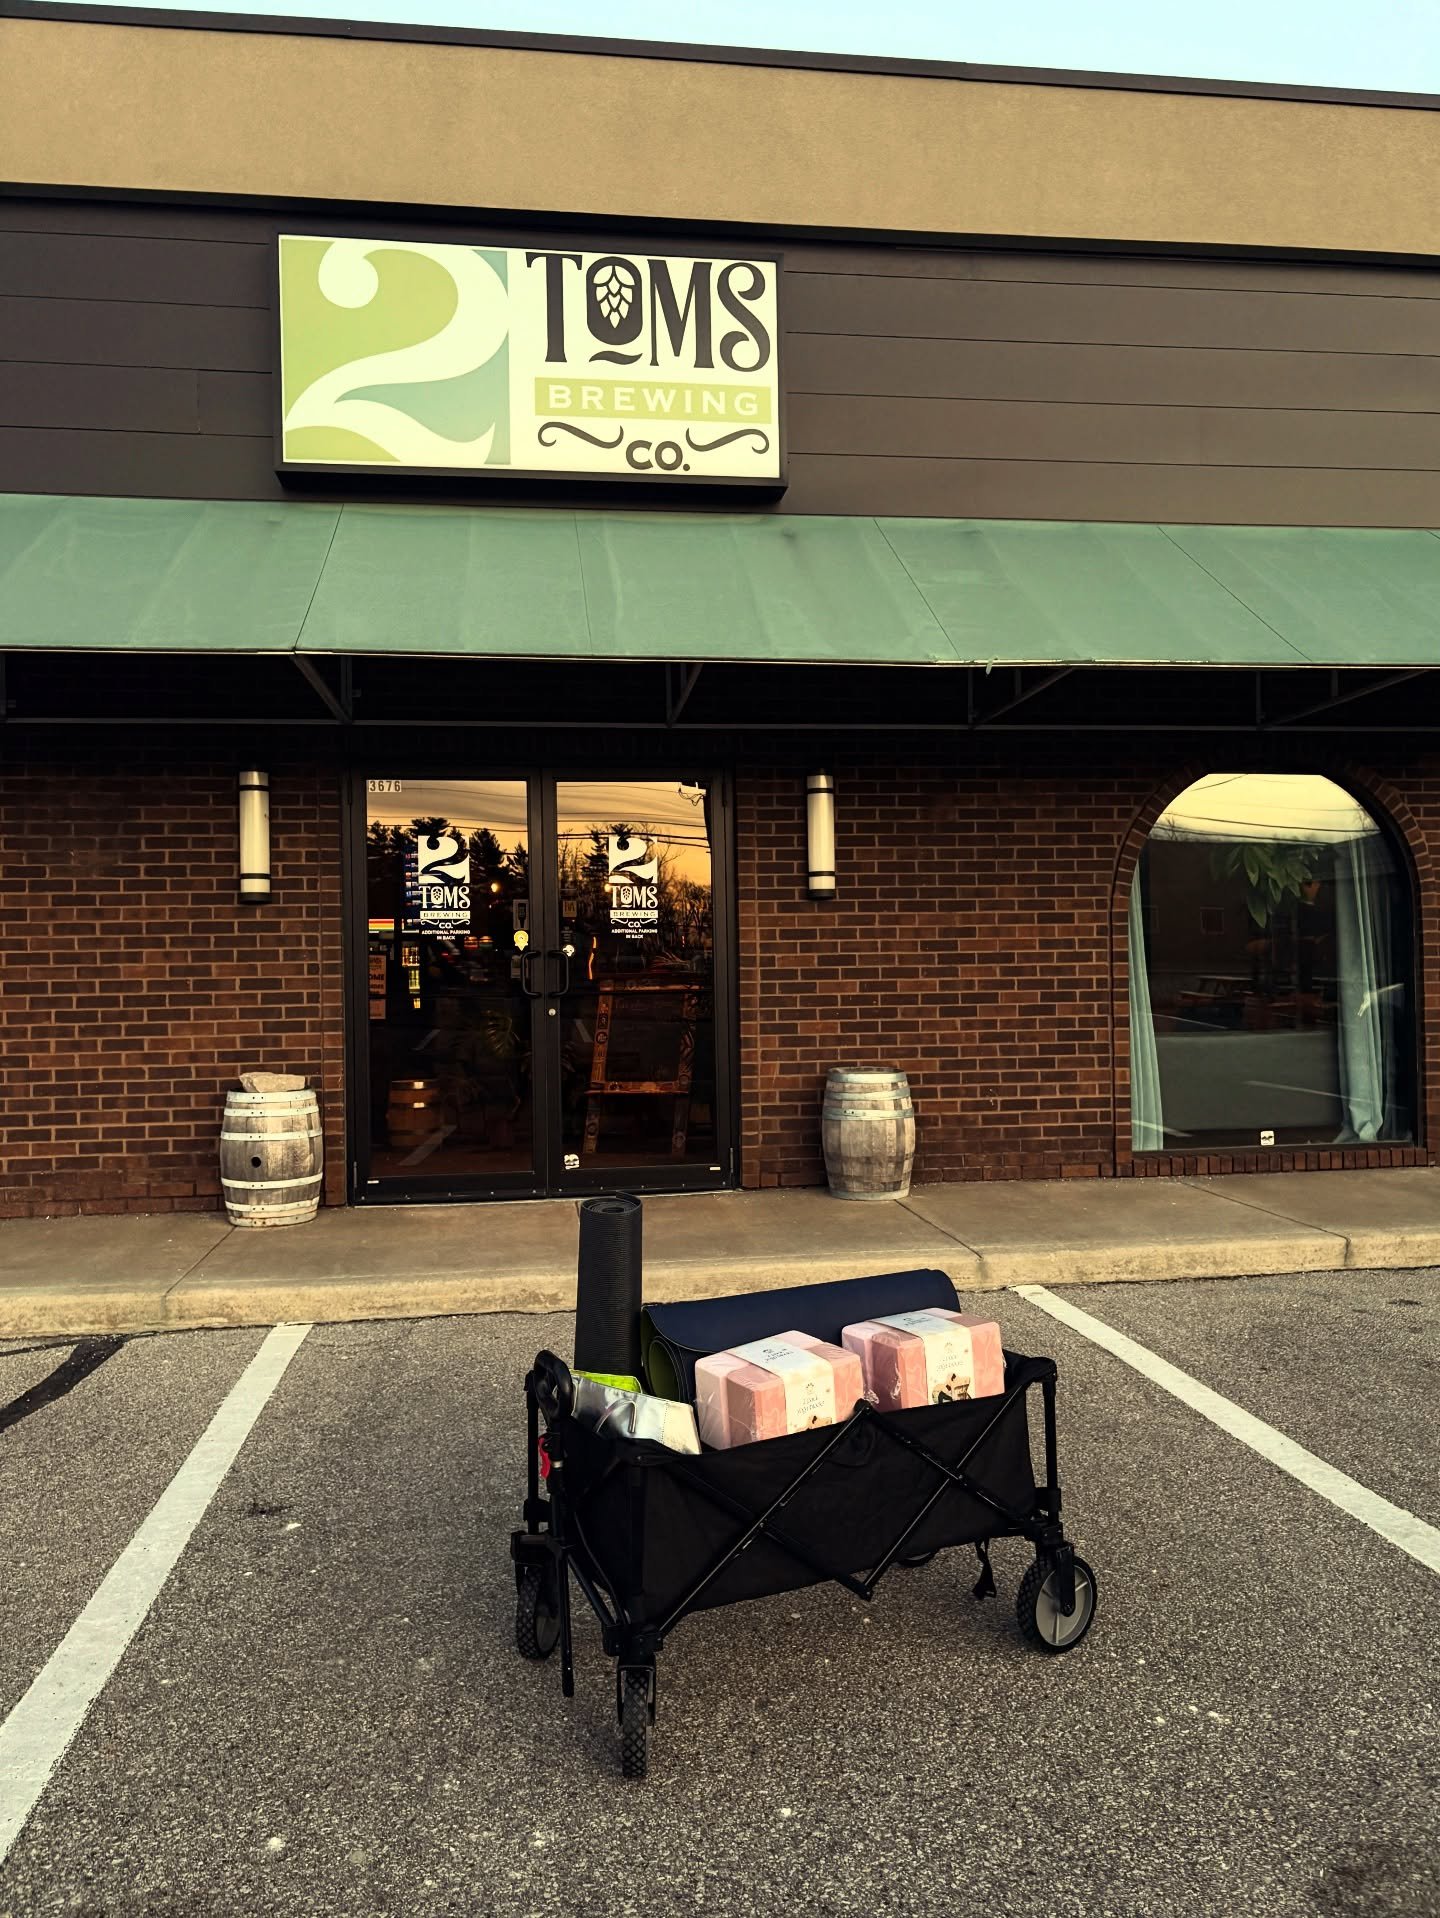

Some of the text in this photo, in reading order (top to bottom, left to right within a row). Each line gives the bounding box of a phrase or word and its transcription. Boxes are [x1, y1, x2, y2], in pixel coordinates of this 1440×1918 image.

[284, 240, 771, 465] 2 TOMS
[548, 384, 759, 416] BREWING
[625, 440, 691, 472] CO.
[370, 780, 401, 791] 3676
[420, 836, 469, 884] 2
[609, 836, 657, 884] 2
[419, 885, 470, 909] TOMS
[611, 885, 658, 909] TOMS
